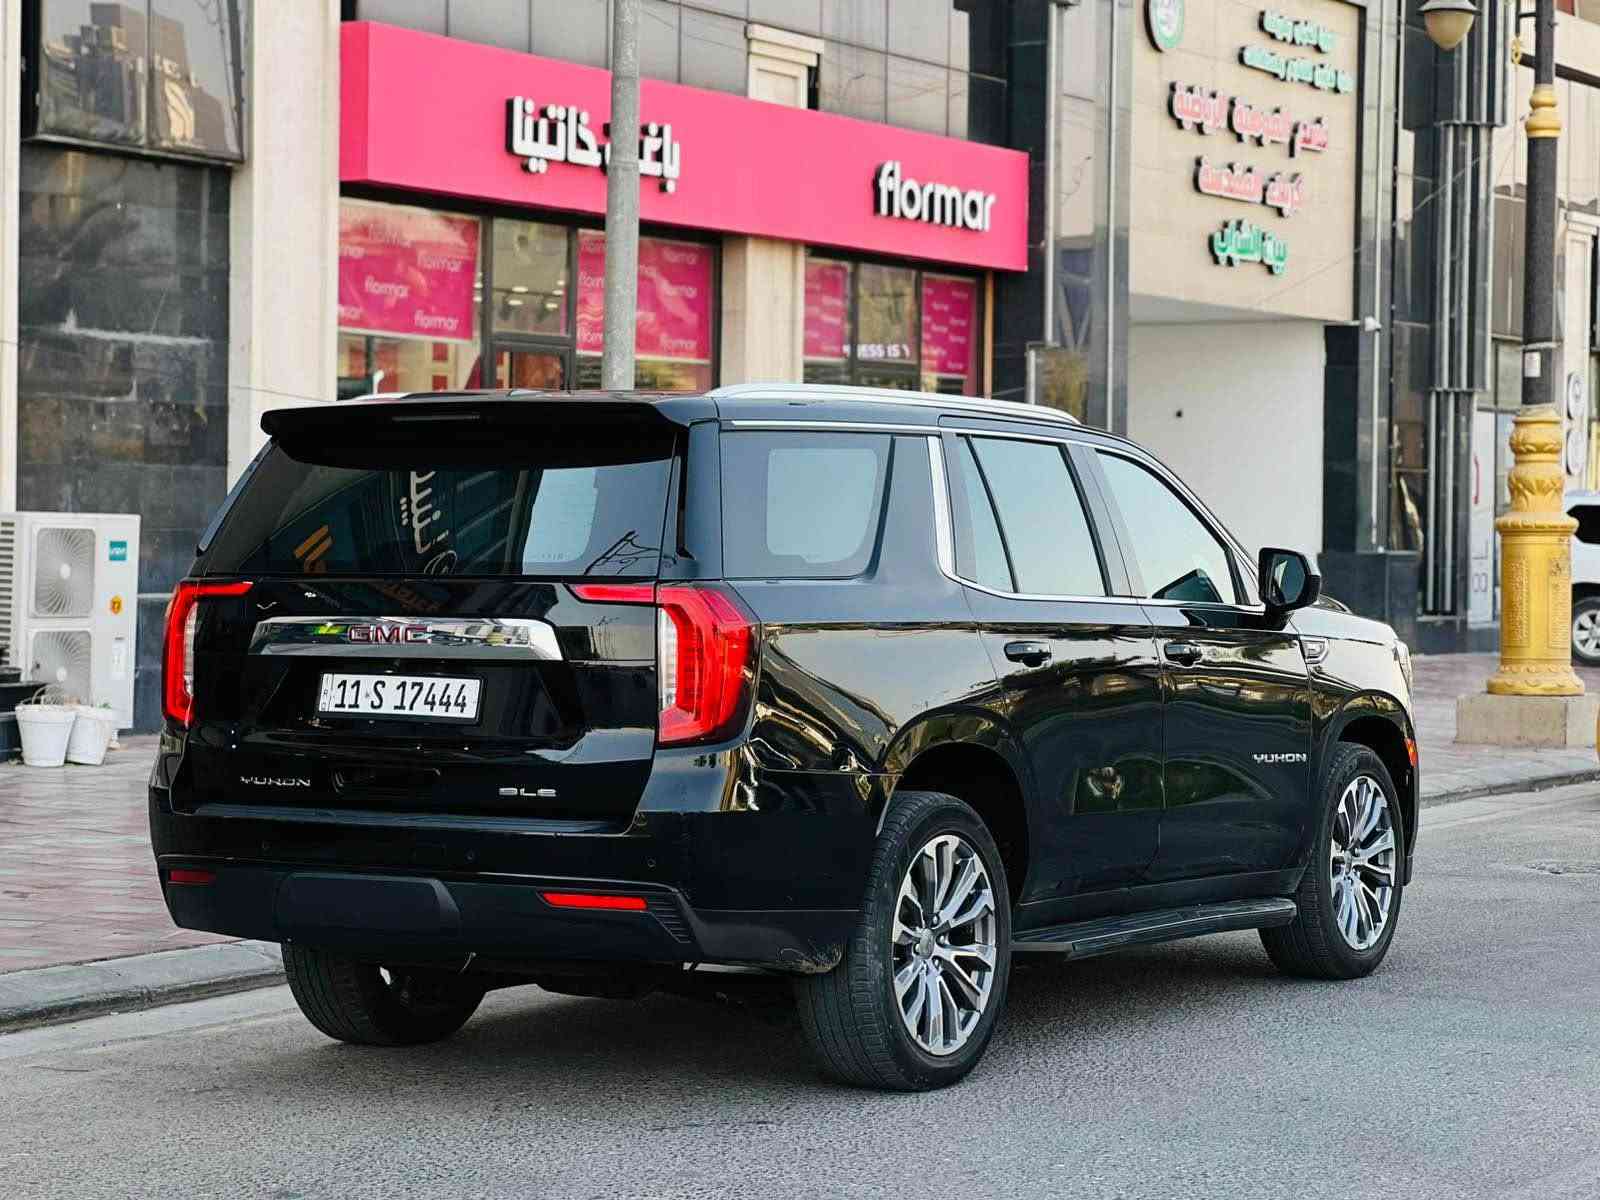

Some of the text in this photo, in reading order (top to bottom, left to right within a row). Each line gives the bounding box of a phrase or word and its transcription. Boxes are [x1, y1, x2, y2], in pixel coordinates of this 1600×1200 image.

[878, 159, 996, 233] flormar
[348, 623, 432, 645] GMC
[334, 679, 468, 713] 11 S 17444
[1253, 753, 1307, 764] YUKON
